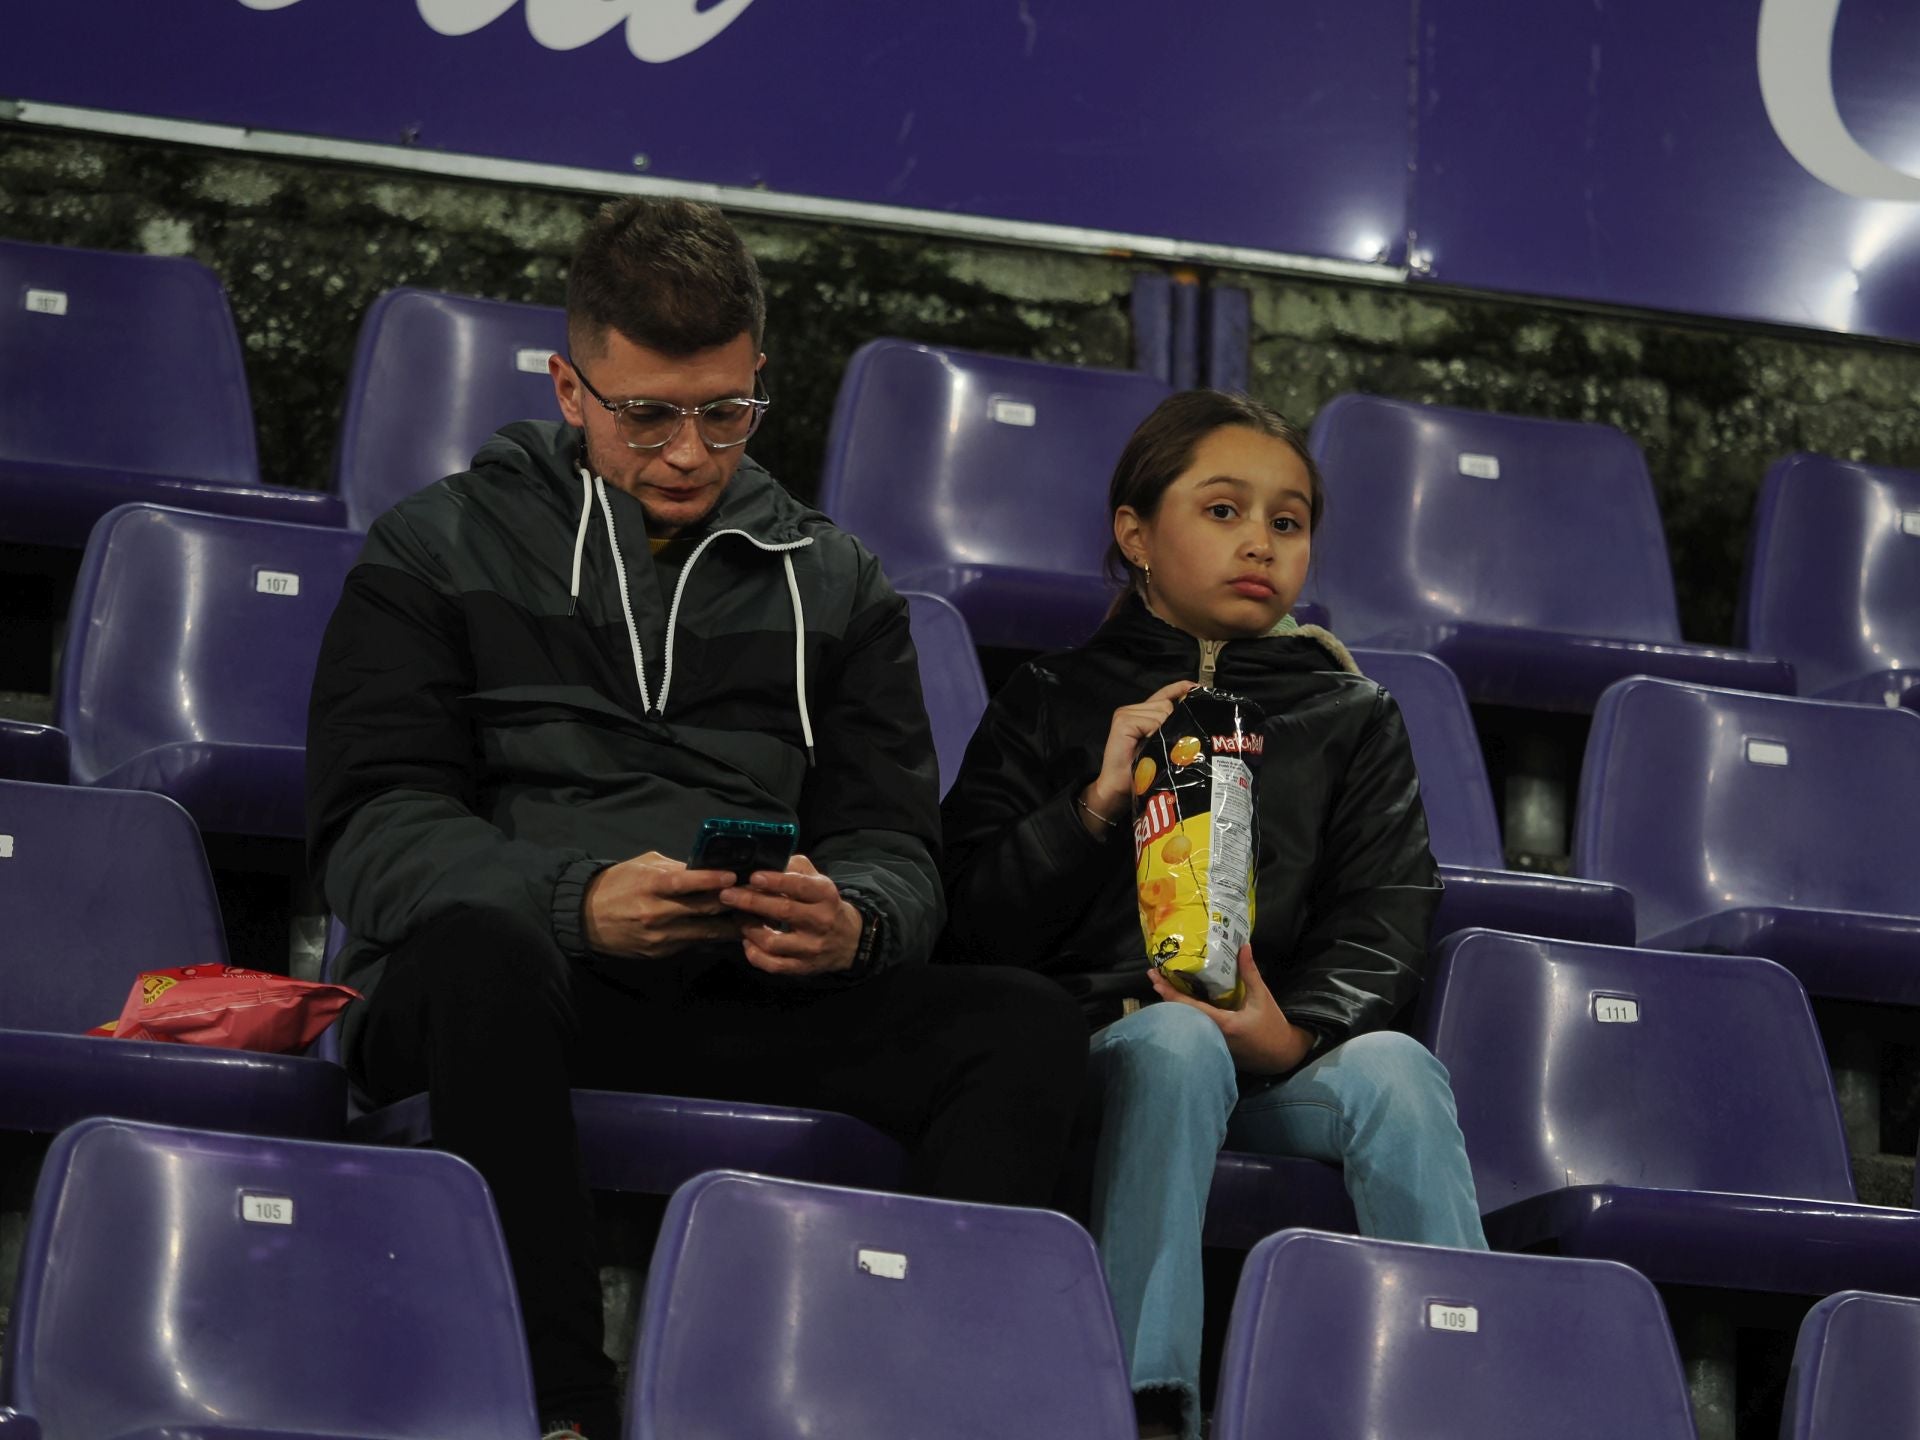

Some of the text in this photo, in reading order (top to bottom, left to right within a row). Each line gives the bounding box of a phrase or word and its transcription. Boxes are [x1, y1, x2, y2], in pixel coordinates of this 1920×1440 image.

[266, 578, 288, 593] 107
[1606, 1006, 1627, 1020] 111
[255, 1203, 281, 1219] 105
[1441, 1312, 1466, 1328] 109
